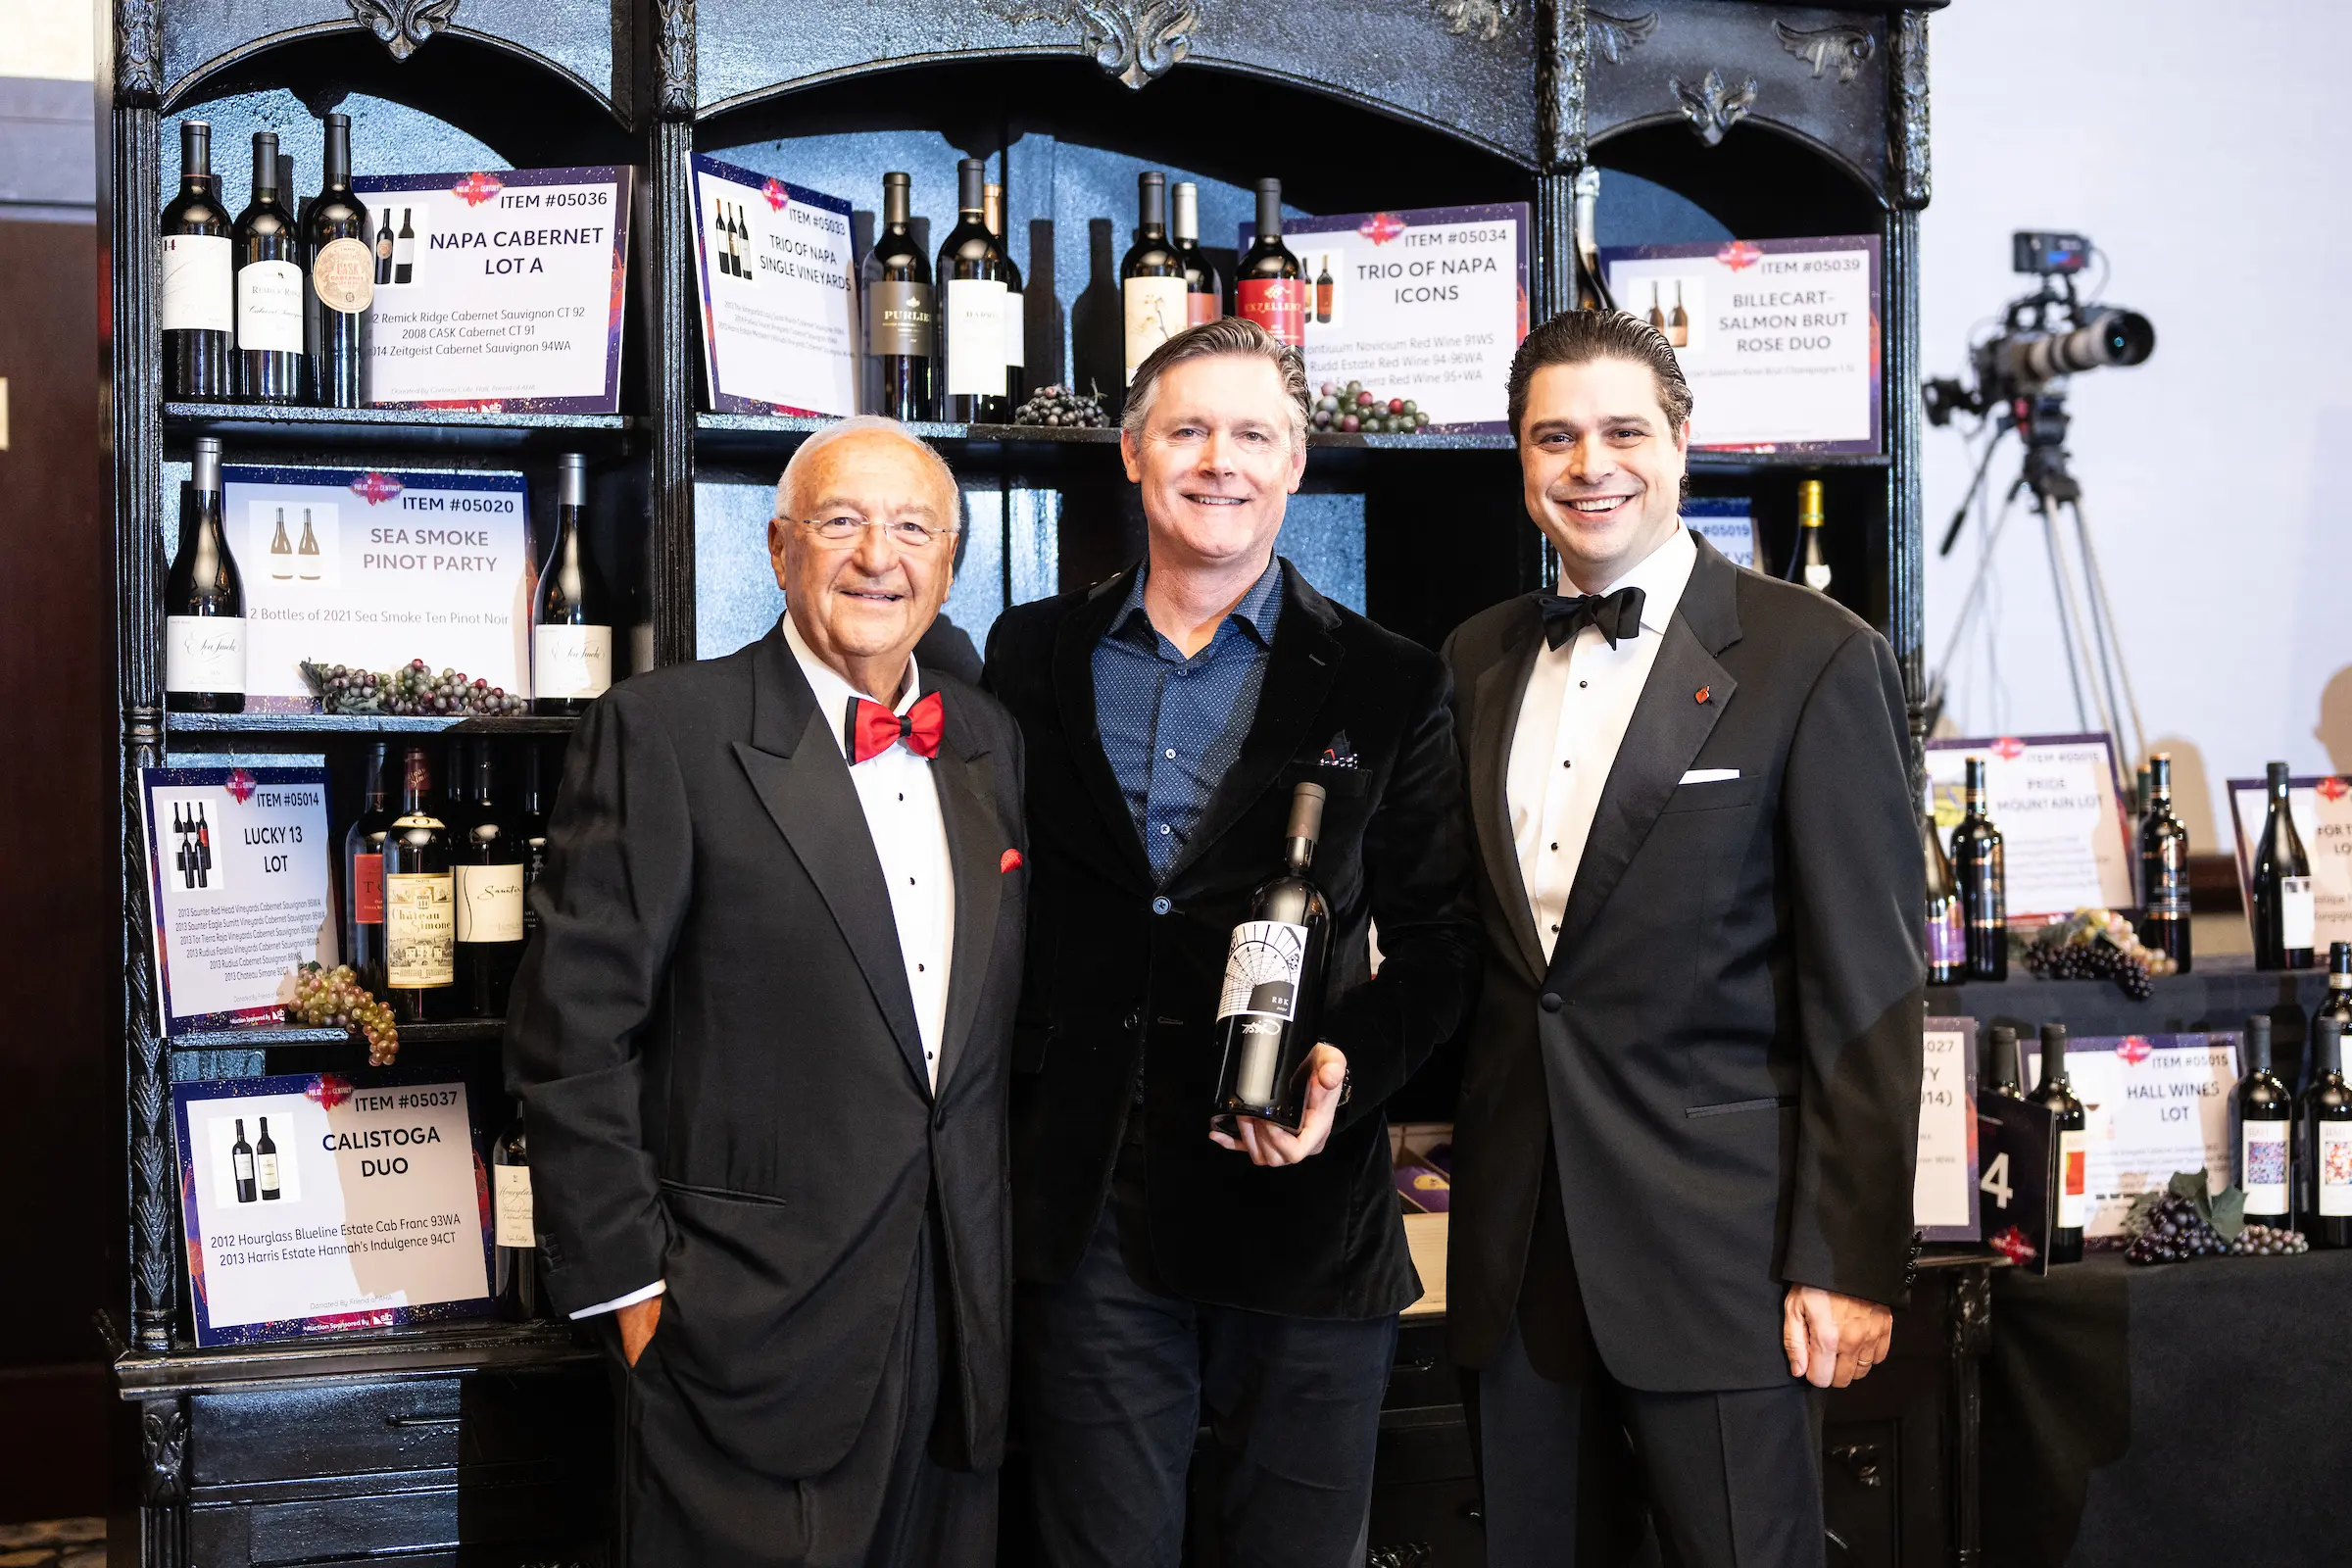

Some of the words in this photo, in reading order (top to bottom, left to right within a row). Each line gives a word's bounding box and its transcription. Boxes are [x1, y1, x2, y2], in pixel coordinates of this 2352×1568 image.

[500, 194, 539, 209] ITEM
[545, 192, 608, 207] #05036
[790, 208, 811, 225] ITEM
[813, 216, 845, 235] #05033
[429, 233, 486, 249] NAPA
[494, 227, 604, 247] CABERNET
[1405, 233, 1443, 247] ITEM
[1447, 229, 1507, 243] #05034
[768, 234, 792, 253] TRIO
[795, 243, 808, 257] OF
[810, 246, 837, 266] NAPA
[485, 258, 524, 274] LOT
[529, 257, 543, 272] A
[760, 255, 795, 277] SINGLE
[796, 265, 851, 291] VINEYARDS
[1356, 263, 1402, 280] TRIO
[1409, 261, 1435, 276] OF
[1442, 257, 1497, 274] NAPA
[1760, 261, 1797, 274] ITEM
[1803, 259, 1860, 272] #05039
[1396, 285, 1459, 304] ICONS
[1733, 290, 1835, 308] BILLECART-
[382, 311, 417, 323] Remick
[419, 310, 448, 325] Ridge
[451, 310, 498, 321] Cabernet
[501, 308, 555, 323] Sauvignon
[557, 308, 571, 318] CT
[572, 307, 585, 318] 92
[1719, 314, 1796, 331] SALMON
[1802, 312, 1848, 327] BRUT
[402, 328, 425, 339] 2008
[428, 327, 456, 339] CASK
[459, 327, 506, 338] Cabernet
[509, 325, 523, 337] CT
[524, 325, 535, 335] 91
[1409, 337, 1430, 349] Red
[1433, 335, 1460, 348] Wine
[1464, 332, 1494, 345] 91WS
[390, 345, 433, 359] Zeitgeist
[435, 344, 482, 355] Cabernet
[485, 342, 539, 357] Sauvignon
[541, 341, 570, 352] 94WA
[1737, 337, 1784, 352] ROSE
[1789, 335, 1831, 351] DUO
[1341, 359, 1375, 370] Estate
[1378, 357, 1398, 368] Red
[1402, 355, 1429, 367] Wine
[1388, 374, 1409, 386] Red
[1412, 372, 1440, 384] Wine
[402, 497, 443, 512] ITEM
[449, 498, 514, 514] #05020
[370, 528, 410, 545] SEA
[416, 529, 488, 547] SMOKE
[363, 553, 427, 570] PINOT
[433, 556, 498, 572] PARTY
[250, 608, 258, 619] 2
[261, 608, 305, 621] Bottles
[308, 609, 320, 621] of
[323, 610, 351, 621] 2021
[355, 611, 378, 622] Sea
[380, 612, 421, 623] Smoke
[425, 612, 447, 623] Ten
[450, 612, 480, 624] Pinot
[484, 613, 510, 625] Noir
[257, 792, 281, 808] ITEM
[284, 792, 318, 806] #05014
[1996, 796, 2074, 811] MOUNTAIN
[245, 827, 286, 845] LUCKY
[289, 826, 303, 843] 13
[265, 855, 288, 873] LOT
[178, 908, 190, 917] 2013
[211, 906, 221, 915] Red
[221, 904, 235, 914] Head
[235, 902, 260, 914] Vineyards
[260, 901, 282, 911] Cabernet
[282, 900, 308, 911] Sauvignon
[175, 922, 188, 932] 2013
[208, 918, 223, 931] Eagle
[239, 915, 265, 927] Vineyards
[265, 913, 287, 924] Cabernet
[288, 913, 312, 925] Sauvignon
[180, 935, 192, 945] 2013
[192, 935, 201, 944] Tor
[227, 929, 253, 942] Vineyards
[253, 927, 274, 938] Cabernet
[275, 926, 300, 939] Sauvignon
[186, 949, 198, 958] 2013
[234, 943, 259, 955] Vineyards
[259, 941, 280, 953] Cabernet
[282, 940, 306, 953] Sauvignon
[210, 960, 221, 970] 2013
[239, 956, 262, 966] Cabernet
[262, 955, 287, 966] Sauvignon
[225, 972, 237, 982] 2013
[237, 970, 259, 980] Chateau
[259, 968, 276, 978] Simone
[1272, 996, 1289, 1005] RBK
[2152, 1056, 2181, 1068] ITEM
[2127, 1084, 2166, 1100] HALL
[2169, 1080, 2220, 1099] WINES
[355, 1096, 394, 1112] ITEM
[398, 1091, 457, 1107] #05037
[2161, 1105, 2189, 1122] LOT
[322, 1126, 441, 1152] CALISTOGA
[361, 1157, 409, 1178] DUO
[1980, 1152, 2013, 1209] 4
[211, 1236, 235, 1249] 2012
[238, 1233, 292, 1247] Hourglass
[296, 1227, 337, 1241] Blueline
[341, 1223, 373, 1236] Estate
[375, 1219, 398, 1233] Cab
[400, 1217, 428, 1230] Franc
[431, 1213, 461, 1227] 93WA
[220, 1254, 244, 1266] 2013
[247, 1250, 279, 1263] Harris
[282, 1248, 316, 1260] Estate
[318, 1241, 368, 1256] Hannah's
[370, 1235, 428, 1251] Indulgence
[430, 1231, 456, 1245] 94CT
[329, 1319, 361, 1329] Sponsored
